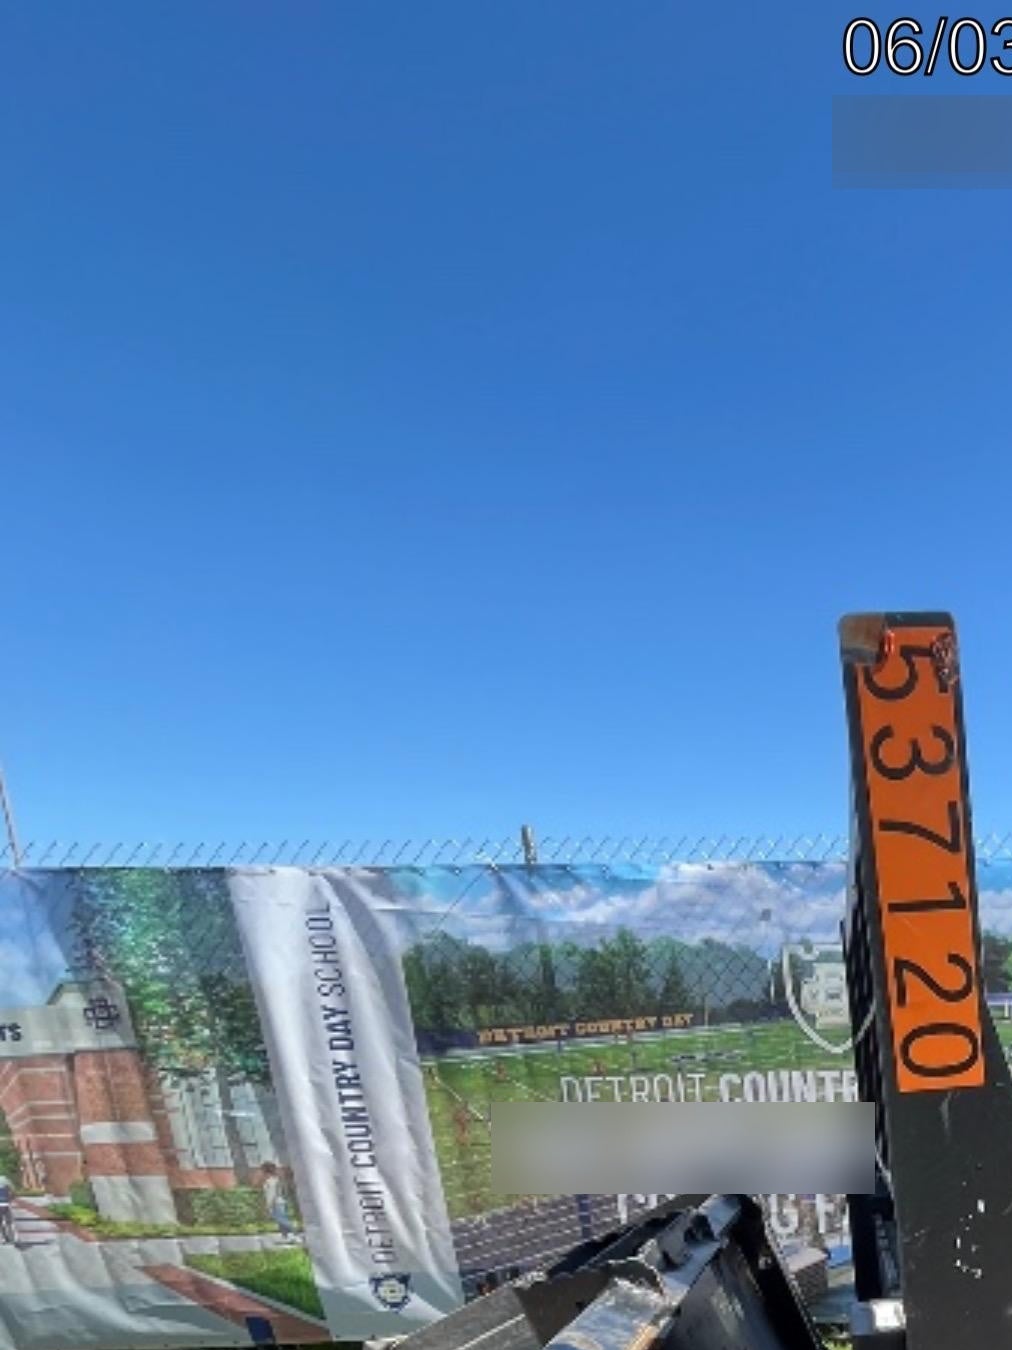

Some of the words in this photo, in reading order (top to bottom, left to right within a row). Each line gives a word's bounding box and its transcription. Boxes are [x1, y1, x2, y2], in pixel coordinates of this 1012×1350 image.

[863, 632, 981, 1079] 537120
[305, 902, 346, 999] SCHOOL
[323, 1004, 356, 1051] DAY
[331, 1061, 376, 1169] COUNTRY
[560, 1073, 706, 1102] DETROIT
[719, 1069, 858, 1102] COUNTR
[356, 1180, 394, 1265] DETROIT
